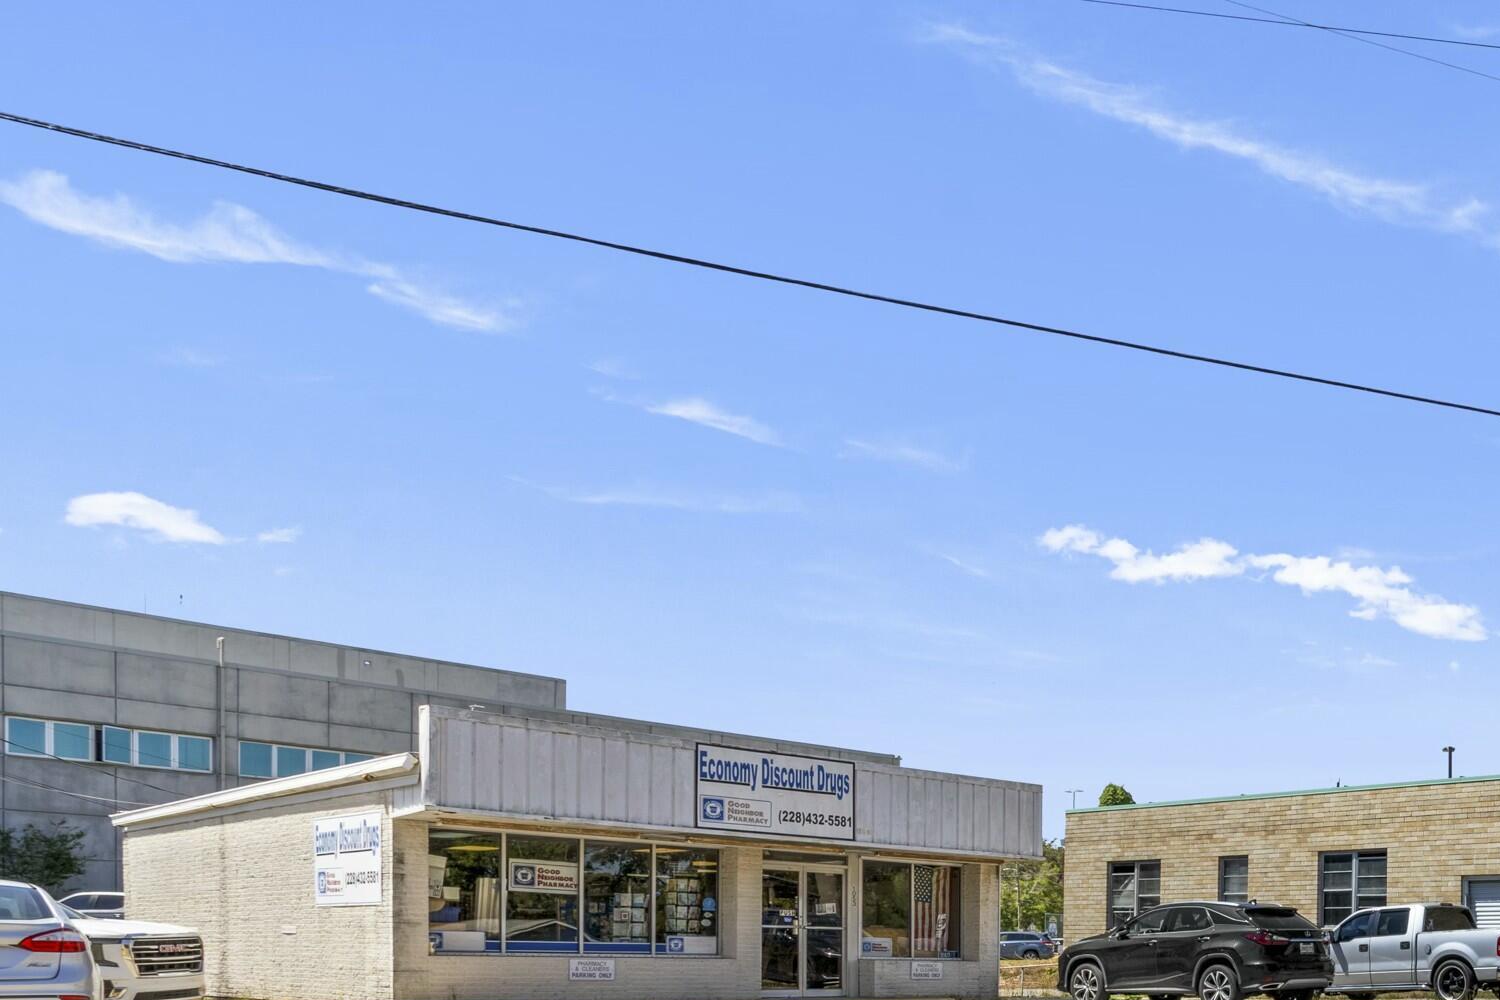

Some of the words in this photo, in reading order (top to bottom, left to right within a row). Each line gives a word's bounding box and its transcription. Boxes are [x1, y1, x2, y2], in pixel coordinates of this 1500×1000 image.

[699, 750, 758, 791] Economy
[761, 757, 815, 791] Discount
[817, 764, 850, 800] Drugs
[315, 824, 338, 860] Economy
[339, 821, 362, 851] Discount
[363, 818, 380, 857] Drugs
[778, 809, 852, 828] (228)432-5581
